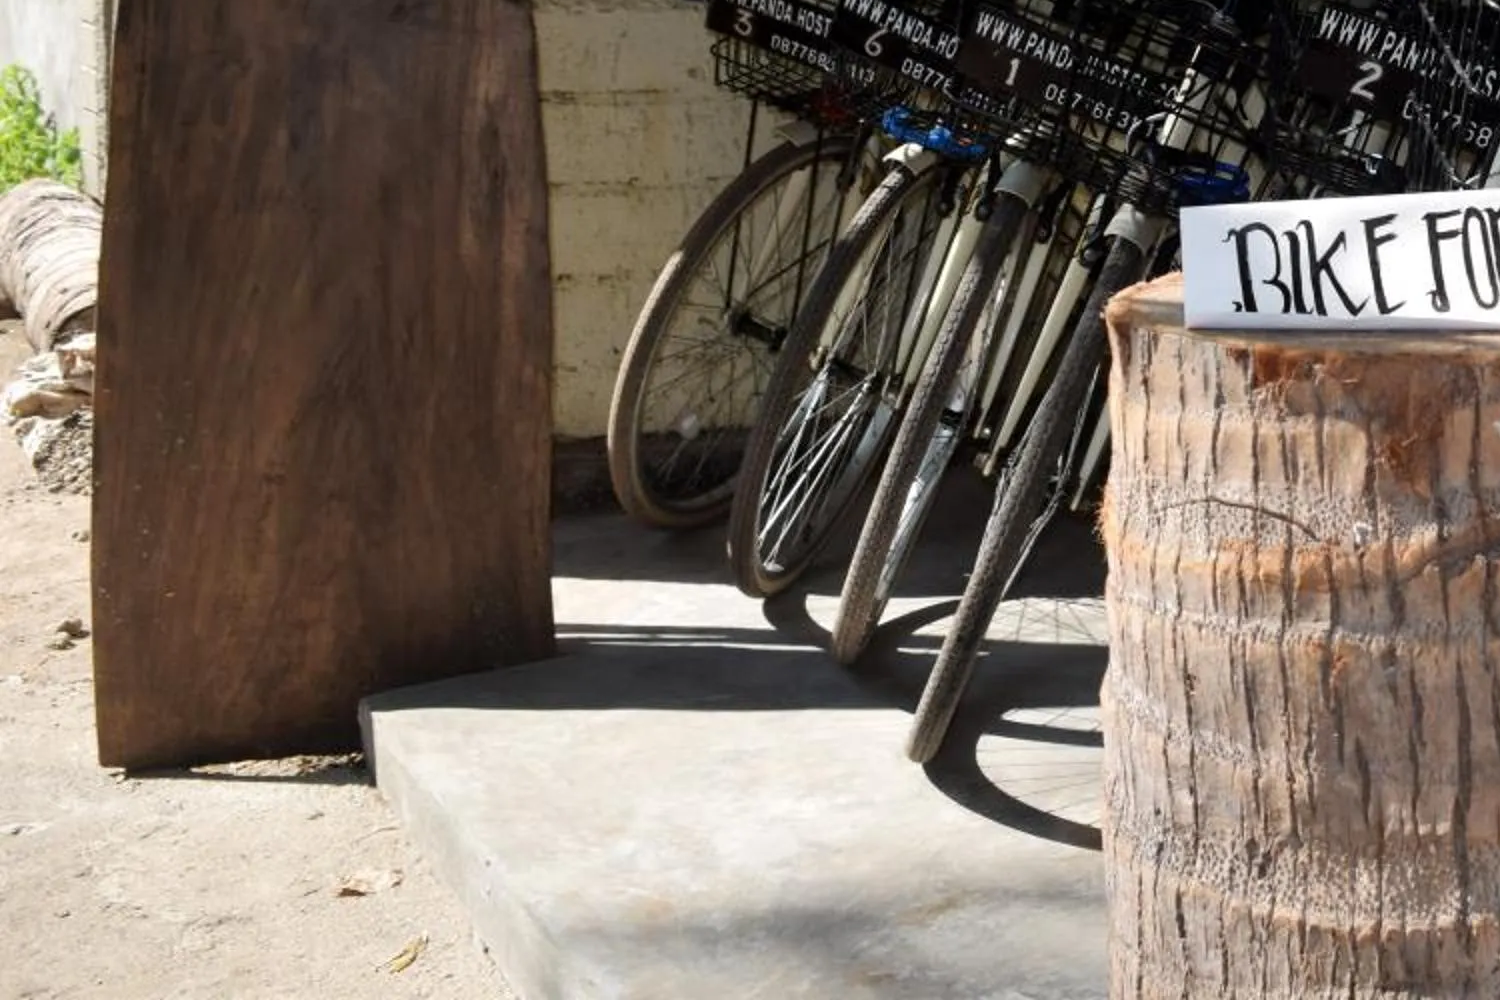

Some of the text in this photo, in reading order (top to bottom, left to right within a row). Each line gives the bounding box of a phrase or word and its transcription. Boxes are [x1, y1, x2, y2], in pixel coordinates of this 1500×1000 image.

[732, 7, 755, 37] 3
[864, 28, 888, 58] 6
[1004, 57, 1021, 87] 1
[1347, 61, 1383, 102] 2
[1221, 212, 1407, 318] BIKE
